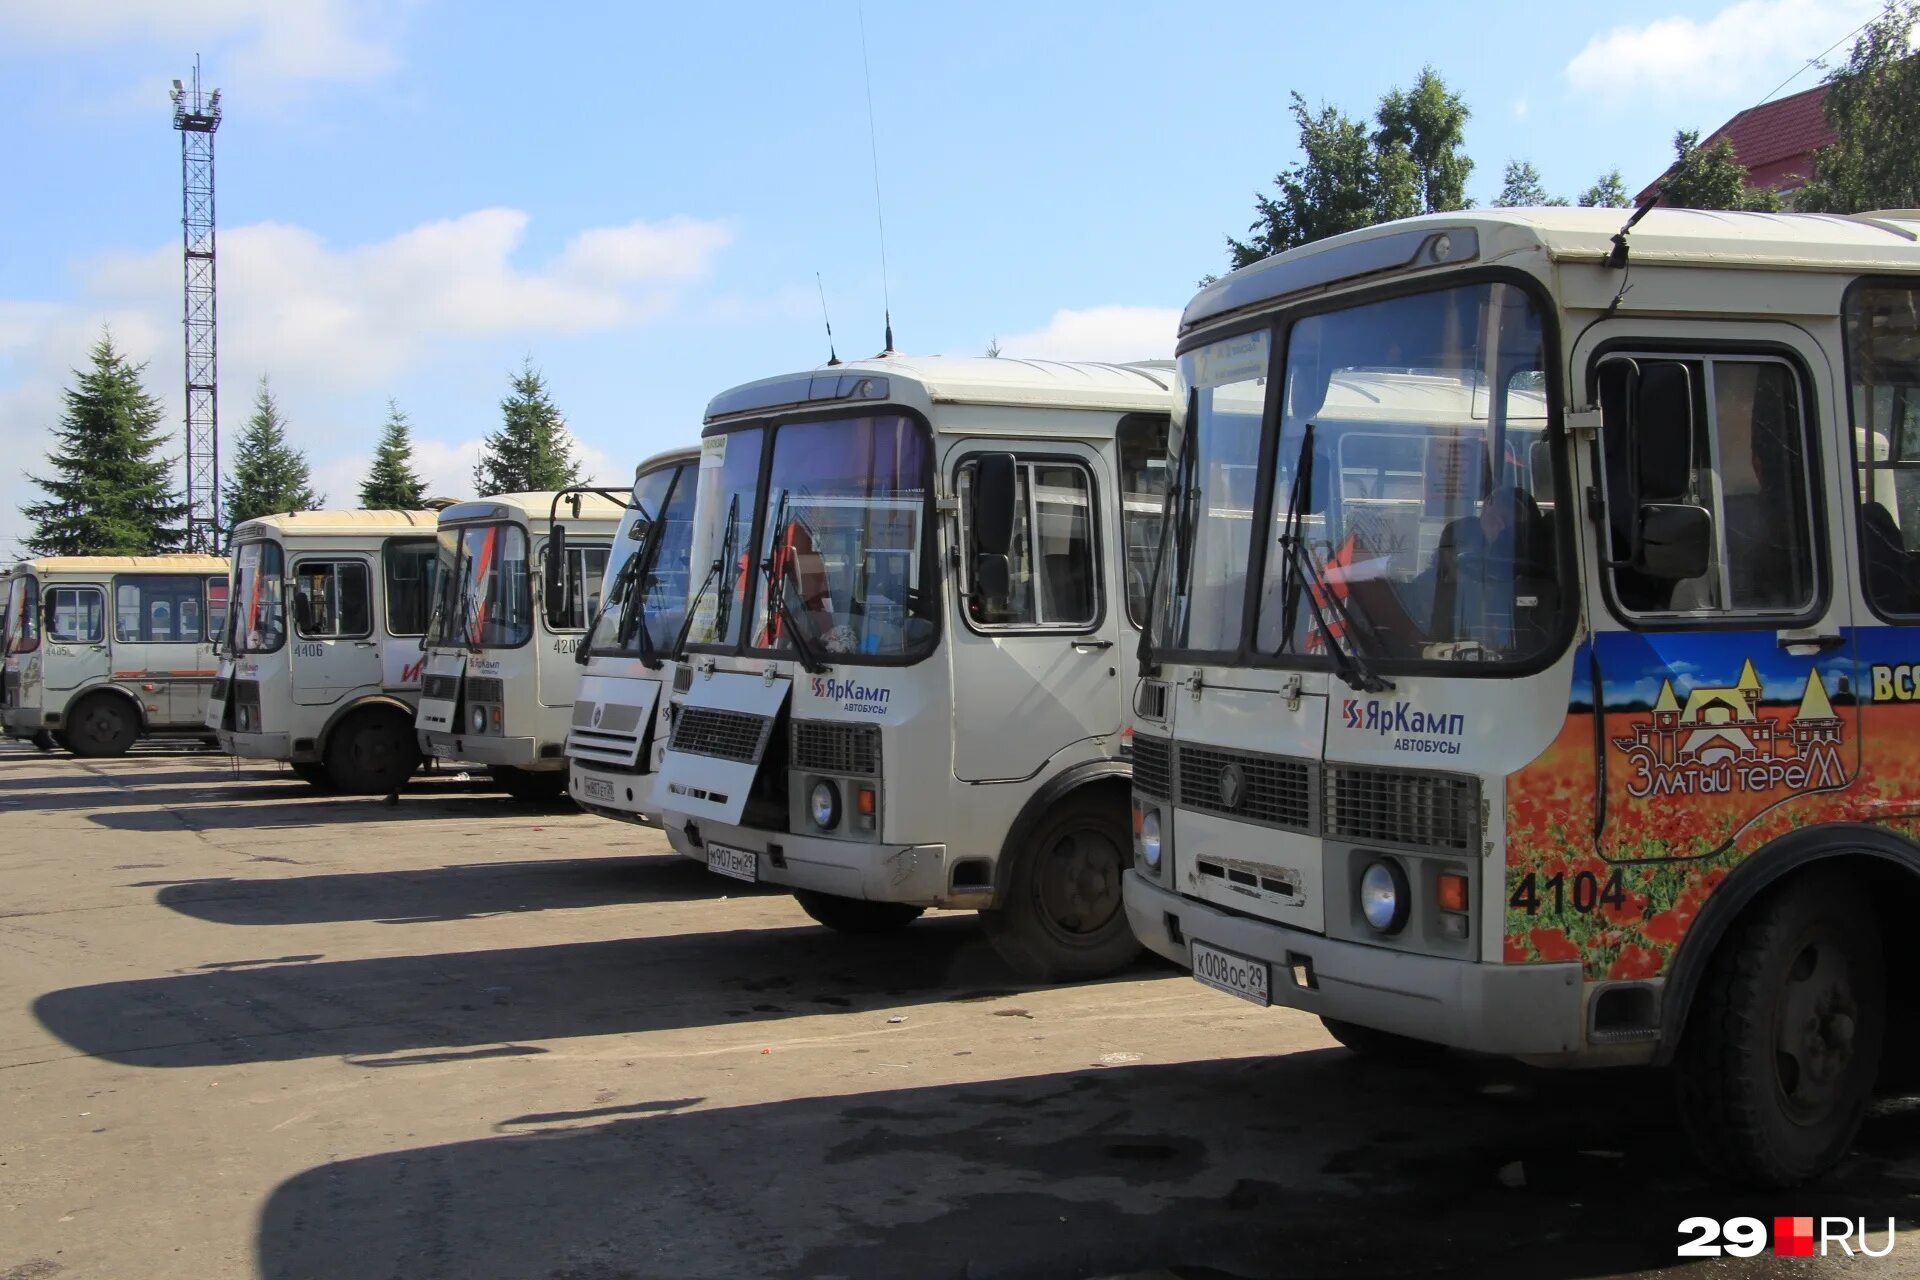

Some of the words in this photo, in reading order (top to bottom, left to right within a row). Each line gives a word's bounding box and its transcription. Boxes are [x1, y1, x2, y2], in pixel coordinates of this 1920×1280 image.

[294, 643, 323, 657] 4406
[826, 679, 890, 702] ЯрКамп
[844, 703, 887, 714] АВТОБУСЫ
[1365, 701, 1464, 735] ЯрКамп
[1394, 738, 1461, 754] АВТОБУСЫ
[1510, 867, 1626, 916] 4104
